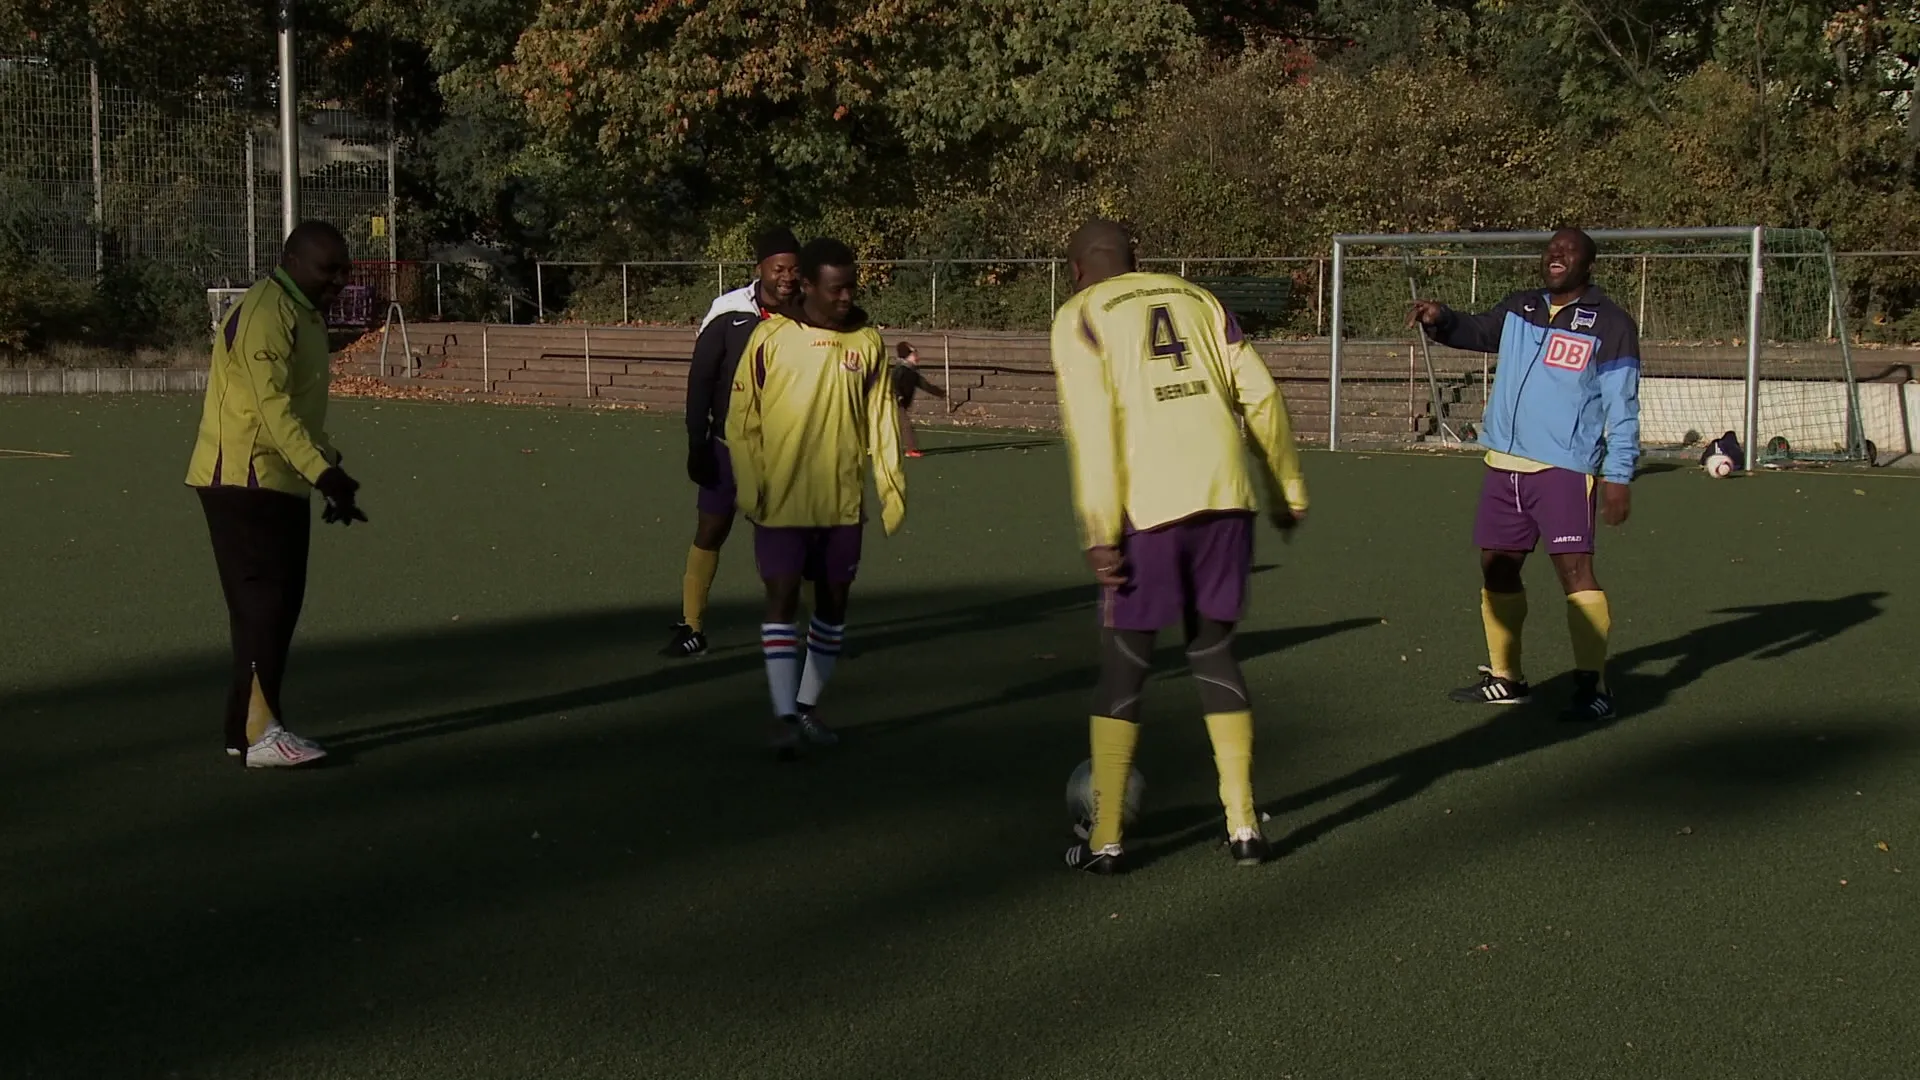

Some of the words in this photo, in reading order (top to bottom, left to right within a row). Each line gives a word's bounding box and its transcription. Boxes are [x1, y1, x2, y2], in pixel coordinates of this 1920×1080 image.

[1146, 303, 1190, 370] 4
[1549, 339, 1584, 365] DB
[1154, 380, 1209, 402] BERLIN
